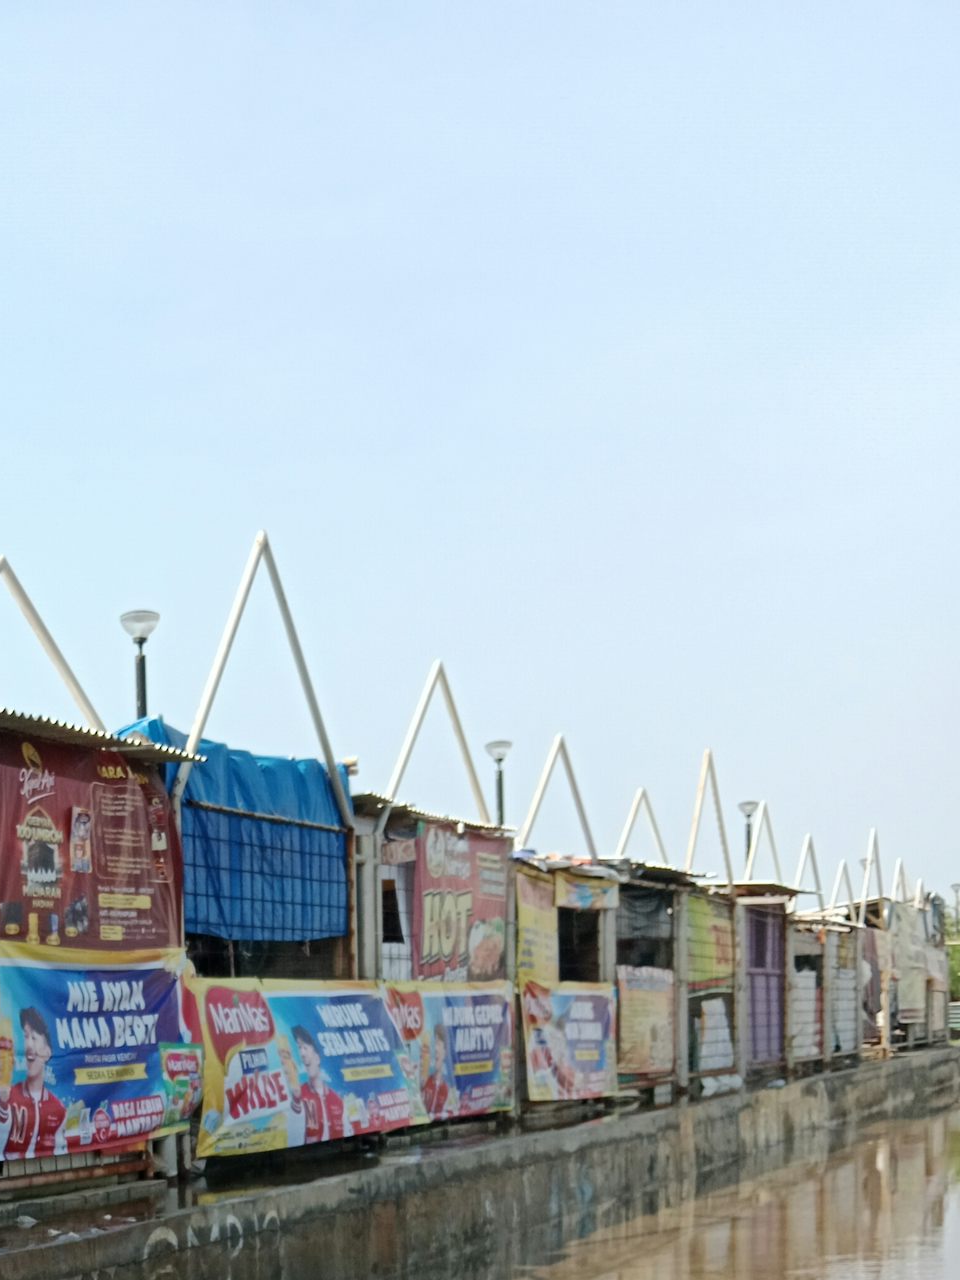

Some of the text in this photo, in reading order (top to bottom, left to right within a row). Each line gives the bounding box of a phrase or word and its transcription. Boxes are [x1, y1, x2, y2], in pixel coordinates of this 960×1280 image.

[66, 980, 146, 1013] MIE AYAM
[56, 1016, 112, 1049] MAMA
[208, 1002, 270, 1035] MariMas
